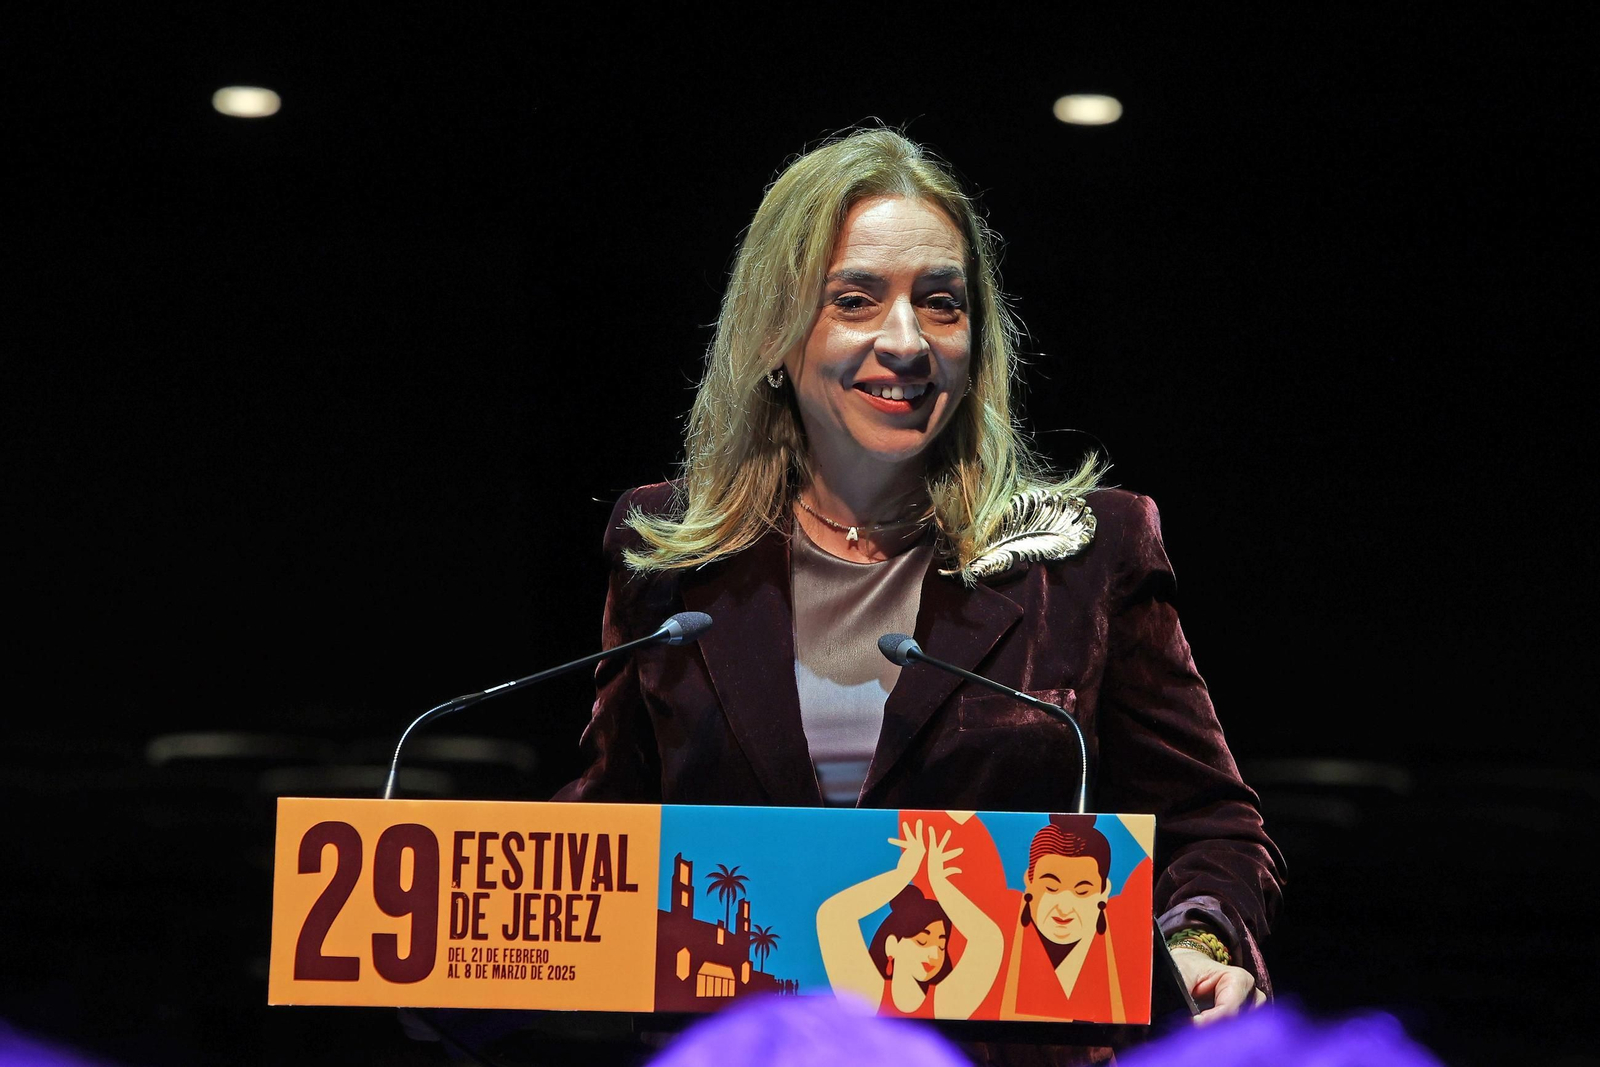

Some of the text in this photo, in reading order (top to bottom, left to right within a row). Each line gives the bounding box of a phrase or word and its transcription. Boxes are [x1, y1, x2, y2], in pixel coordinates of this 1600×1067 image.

[846, 526, 858, 541] A
[450, 830, 639, 893] FESTIVAL
[293, 820, 440, 985] 29
[449, 891, 602, 943] DE JEREZ
[447, 963, 576, 981] AL 8 DE MARZO DE 2025
[448, 946, 549, 964] DEL 21 DE FEBRERO
